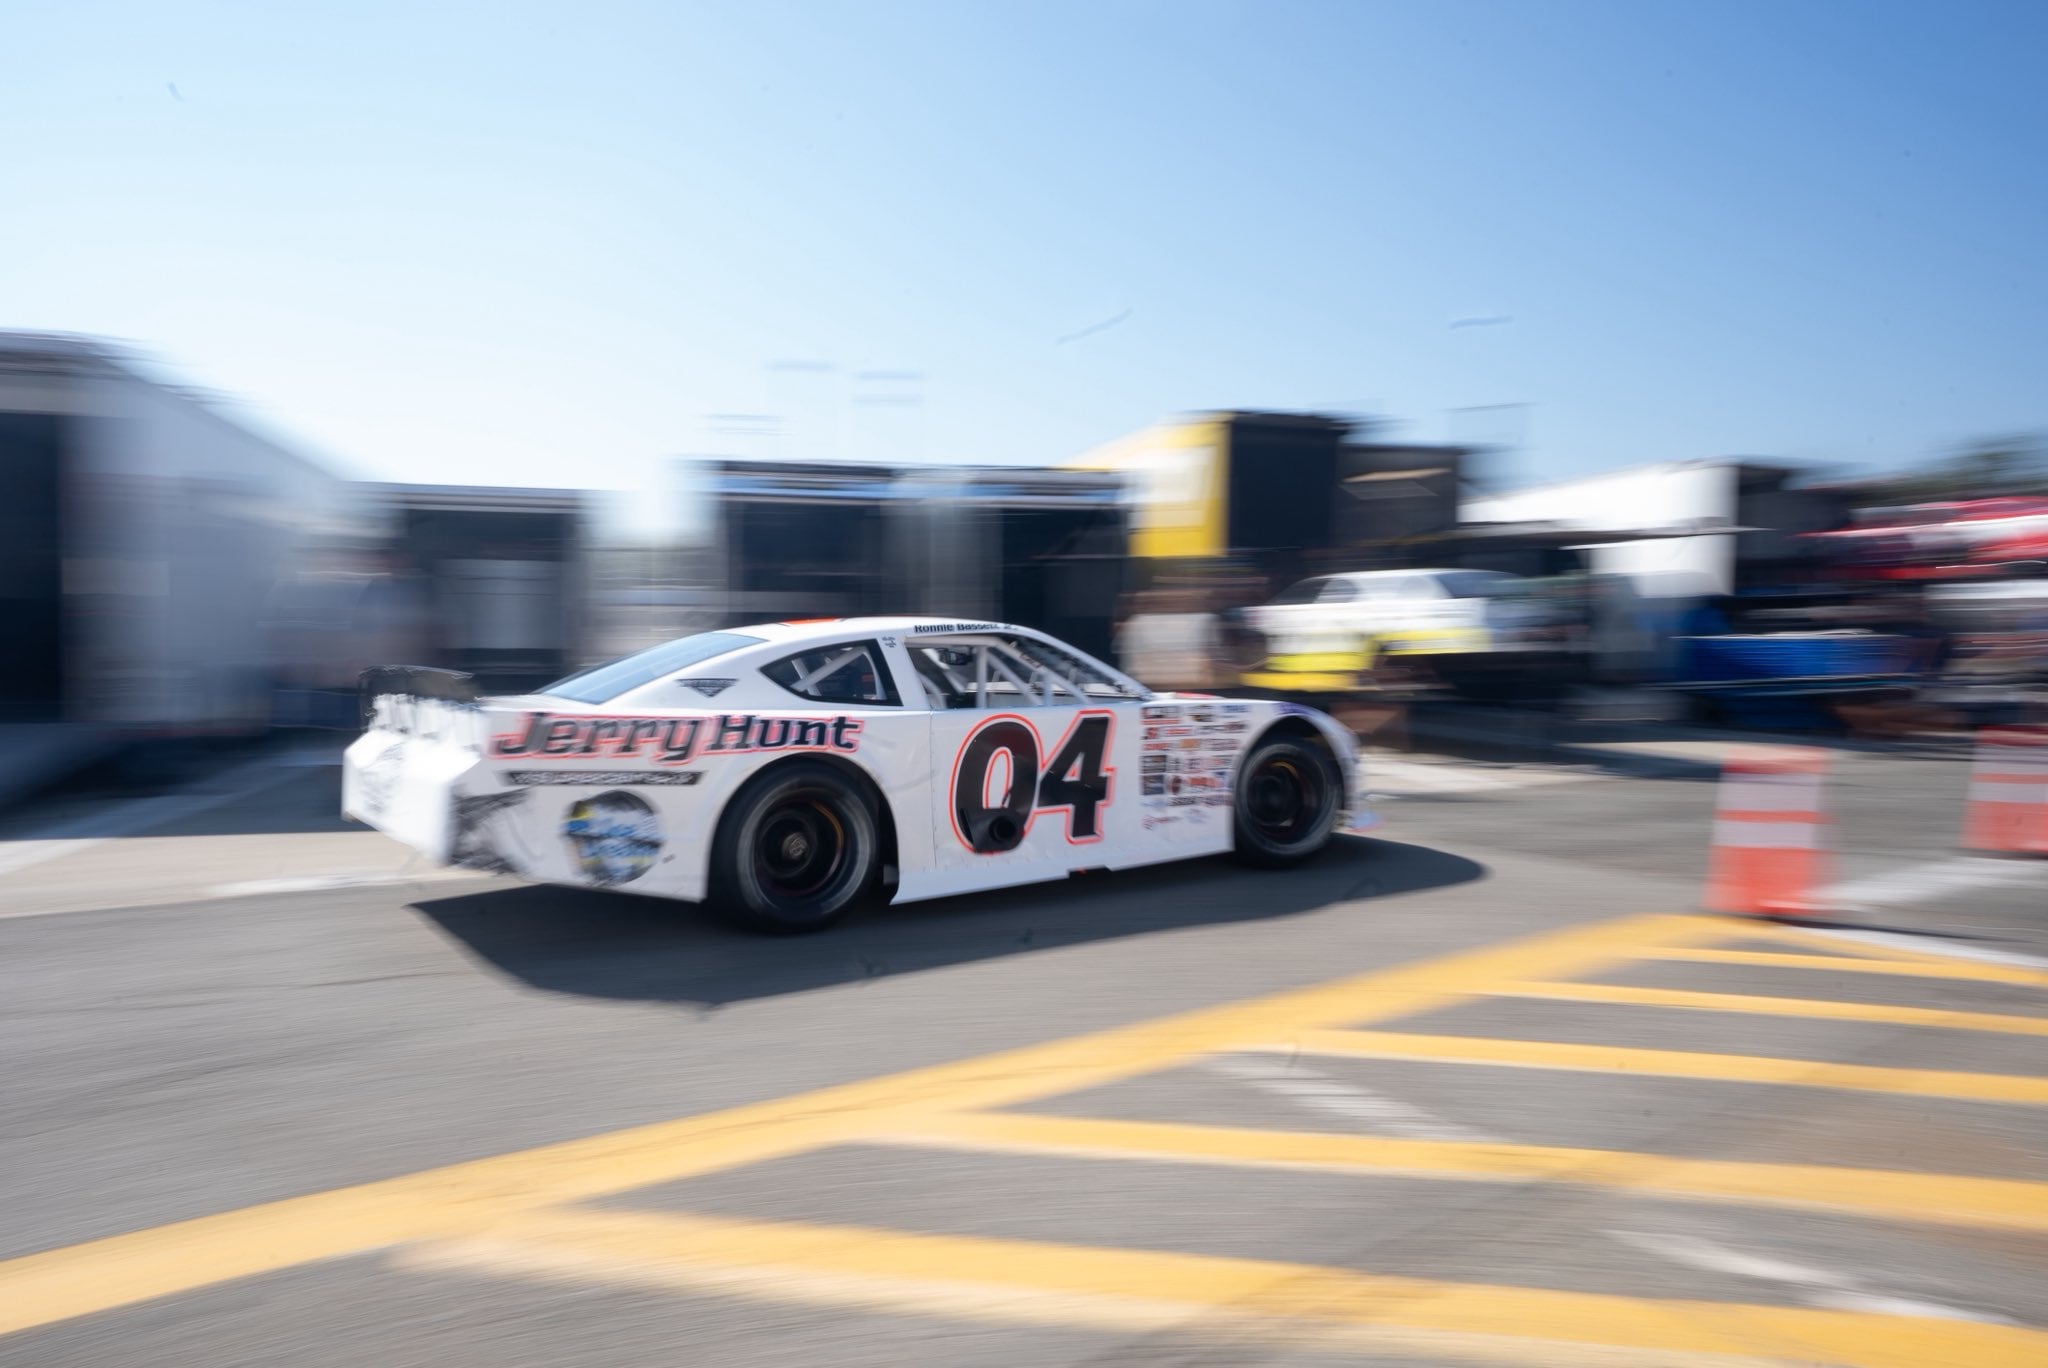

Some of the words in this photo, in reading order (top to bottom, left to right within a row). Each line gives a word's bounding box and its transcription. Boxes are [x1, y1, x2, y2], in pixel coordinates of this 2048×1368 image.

[914, 623, 954, 633] Ronnie
[493, 711, 699, 762] Jerry
[705, 713, 863, 752] Hunt
[950, 710, 1116, 855] 04
